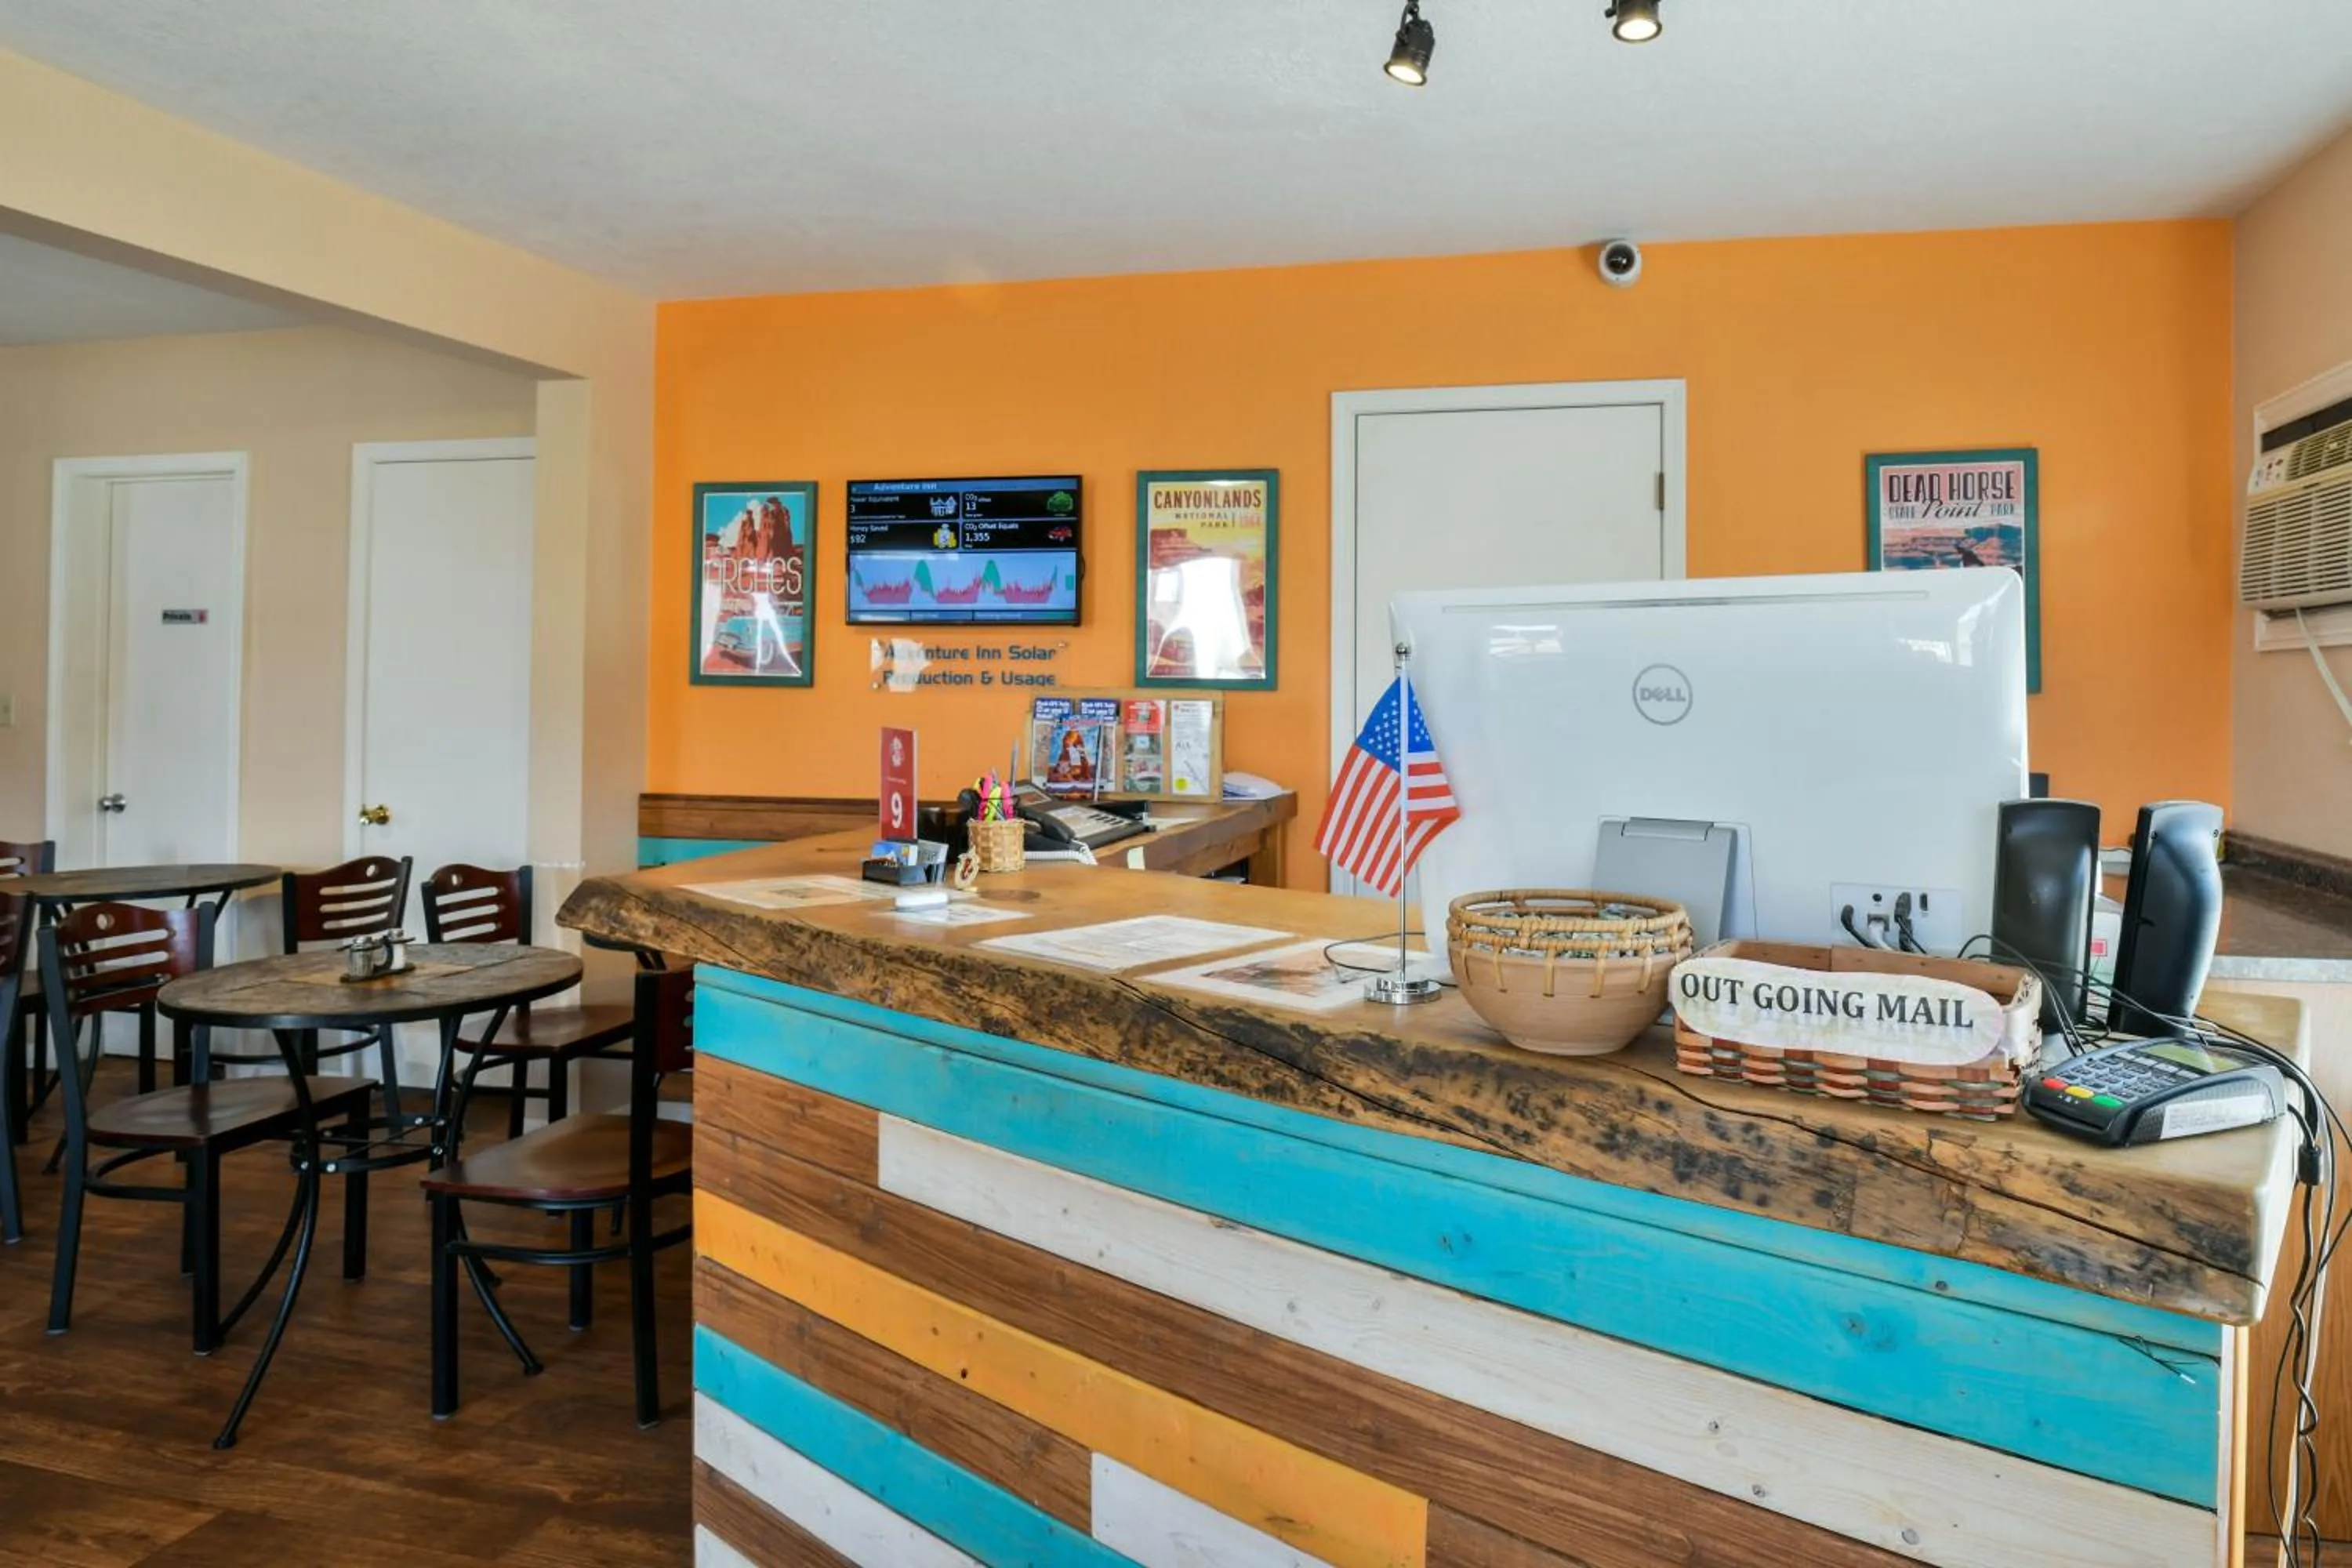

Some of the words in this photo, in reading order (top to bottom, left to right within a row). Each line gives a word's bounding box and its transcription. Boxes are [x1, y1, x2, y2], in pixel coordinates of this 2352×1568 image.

[1889, 473, 1941, 503] DEAD
[1948, 470, 2016, 501] HORSE
[965, 502, 977, 510] 13
[1154, 488, 1261, 509] CANYONLANDS
[1175, 512, 1229, 521] NATIONAL
[1922, 499, 1984, 519] Point
[884, 645, 971, 660] Anture
[976, 645, 1001, 659] Inn
[1008, 645, 1056, 660] Solar
[883, 670, 973, 685] Puction
[980, 670, 993, 684] &
[1639, 687, 1686, 702] DELL
[890, 792, 903, 829] 9
[1681, 972, 1744, 1004] OUT
[1753, 982, 1865, 1018] GOING
[1877, 993, 1973, 1029] MAIL
